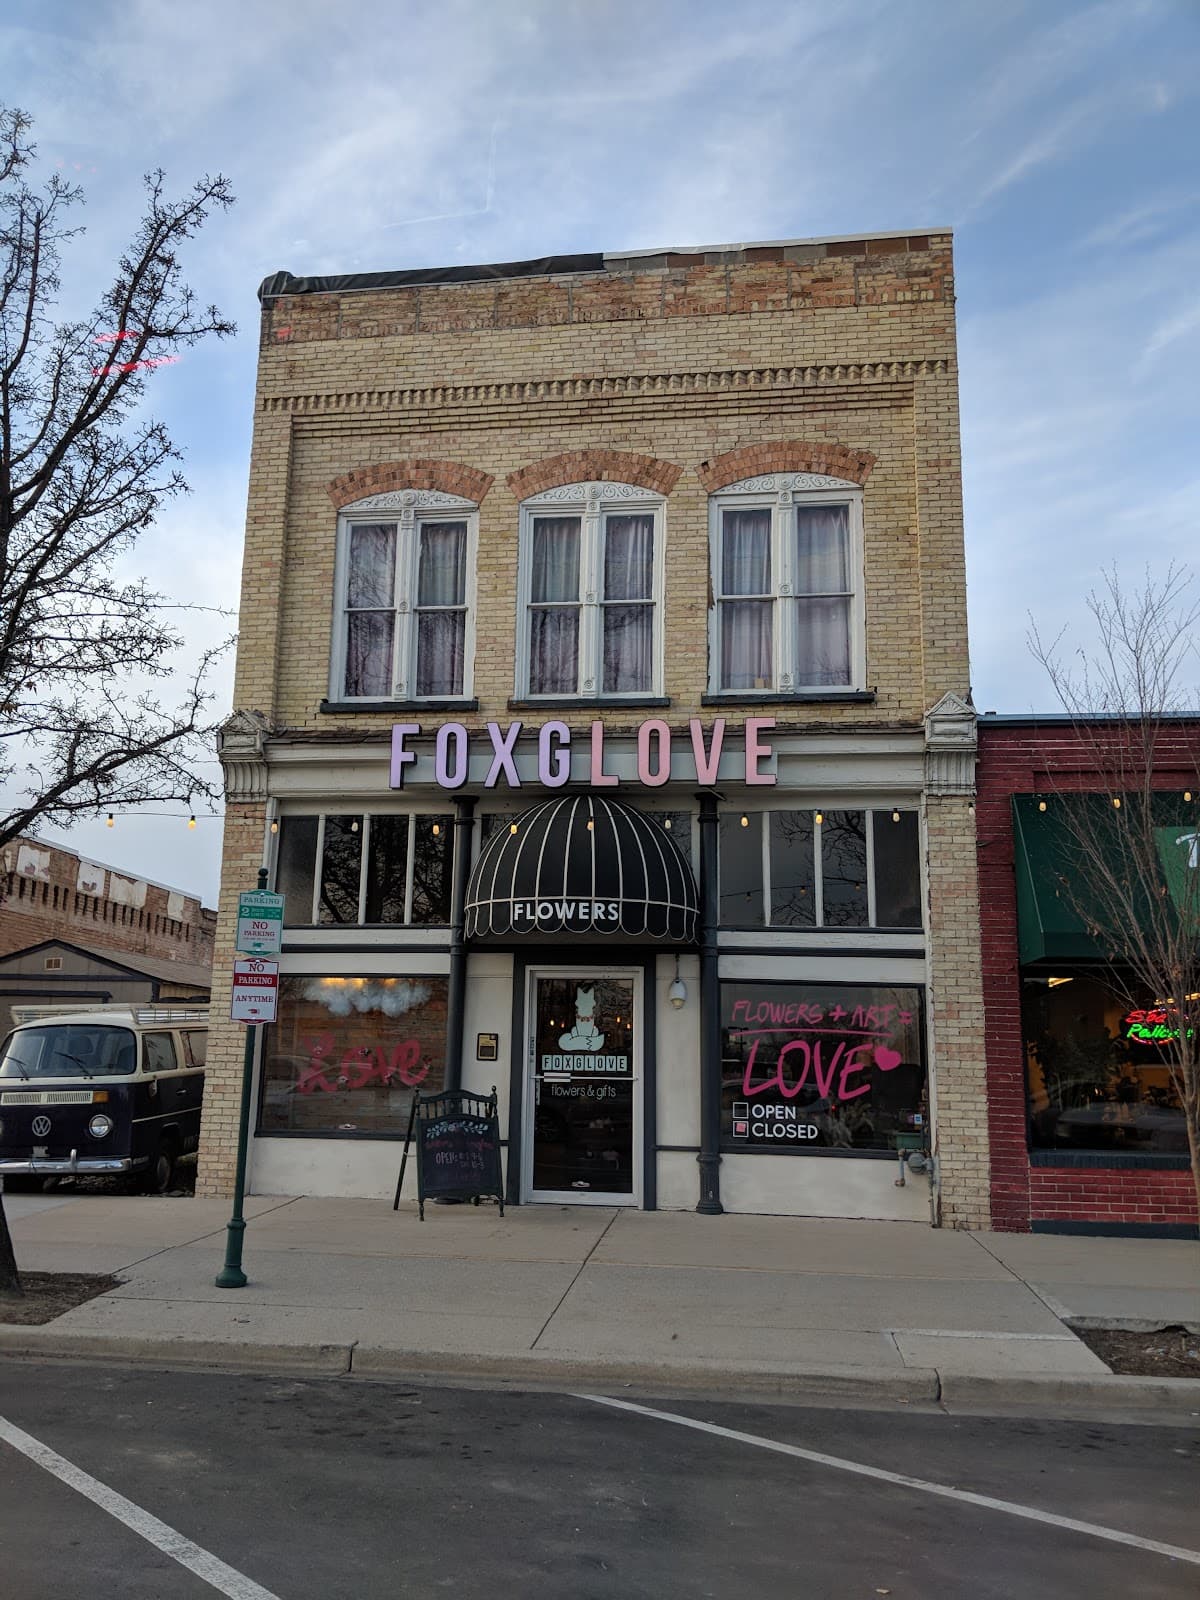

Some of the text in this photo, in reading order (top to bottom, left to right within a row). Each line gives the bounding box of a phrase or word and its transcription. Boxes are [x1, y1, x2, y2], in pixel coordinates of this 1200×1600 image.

[389, 717, 777, 789] FOXGLOVE
[243, 896, 280, 905] PARKING
[241, 907, 249, 917] 2
[514, 901, 619, 921] FLOWERS
[252, 921, 268, 930] NO
[248, 963, 265, 973] NO
[238, 976, 273, 985] PARKING
[236, 995, 274, 1003] ANYTIME
[731, 1000, 824, 1024] FLOWERS
[851, 1004, 897, 1027] ART
[544, 1057, 625, 1070] FOXGLOVE
[742, 1039, 873, 1100] LOVE
[551, 1084, 616, 1100] flowers & gifts
[751, 1104, 797, 1120] OPEN
[751, 1122, 818, 1139] CLOSED
